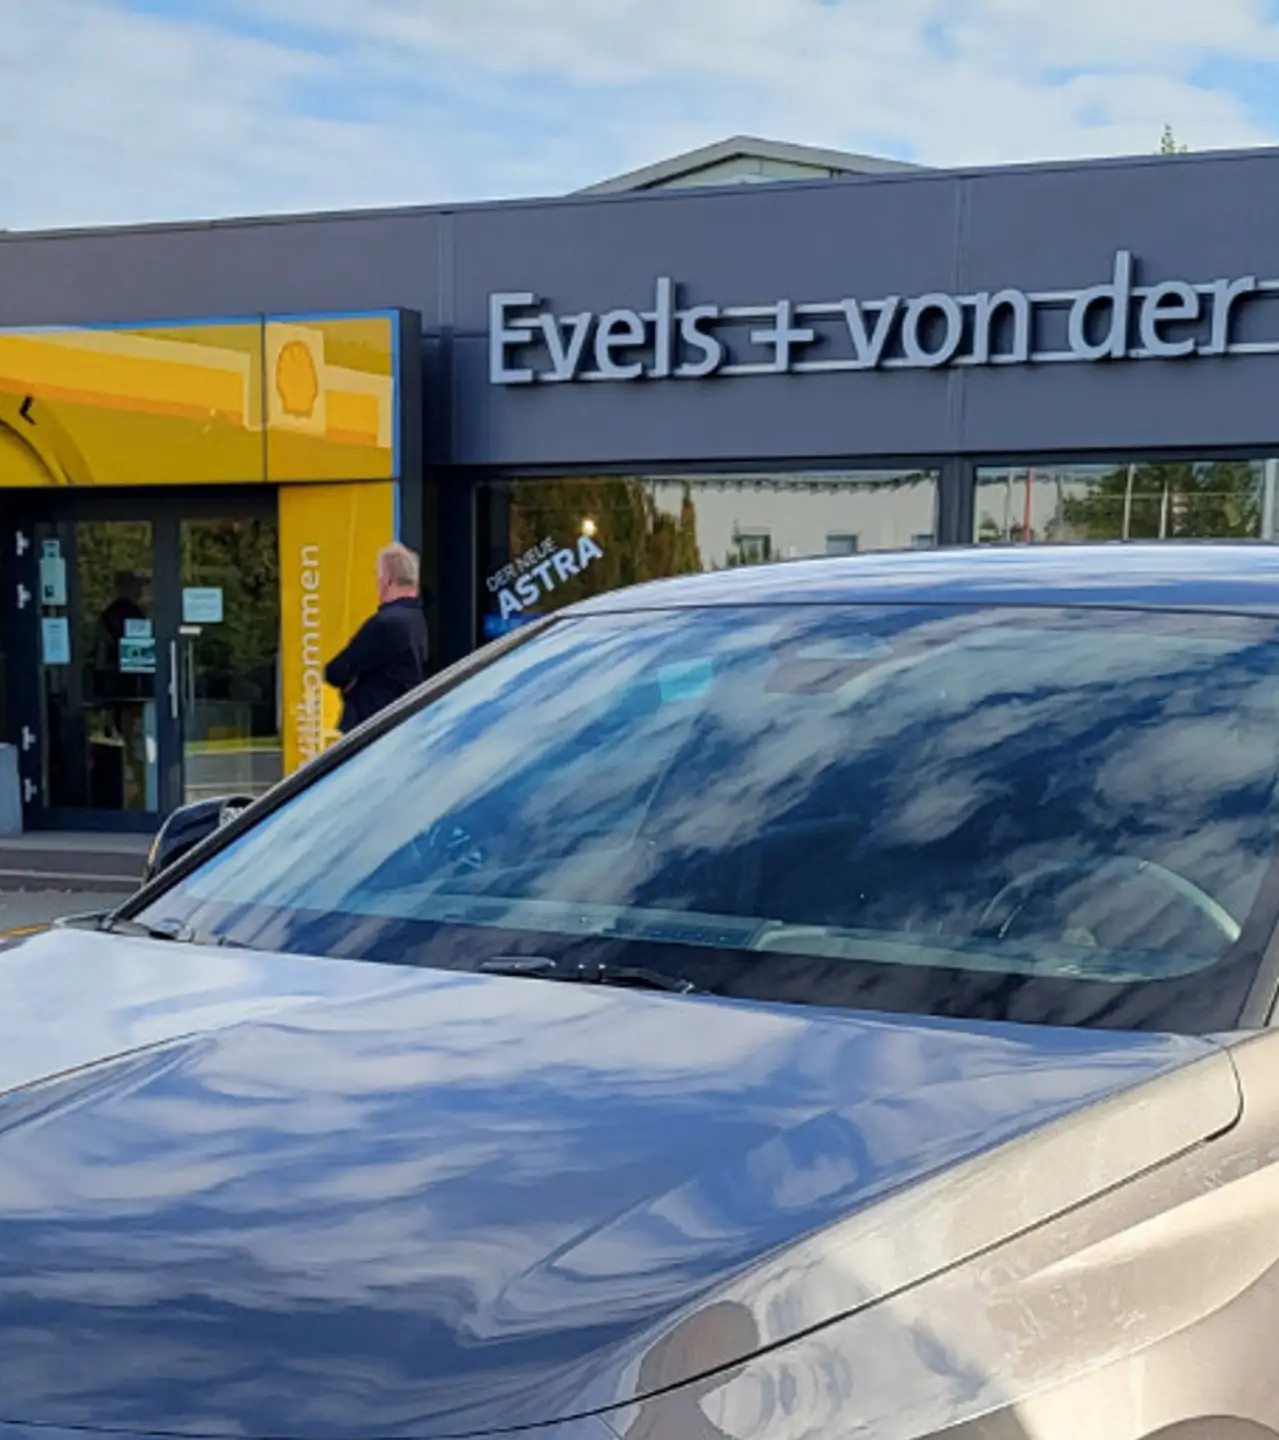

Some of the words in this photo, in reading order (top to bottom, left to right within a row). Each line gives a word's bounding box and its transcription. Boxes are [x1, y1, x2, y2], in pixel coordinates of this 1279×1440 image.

[489, 276, 722, 384] Evels
[750, 300, 814, 373] +
[839, 289, 1031, 368] von
[1067, 249, 1258, 359] der
[486, 564, 517, 592] DER
[515, 537, 557, 572] NEUE
[497, 535, 604, 620] ASTRA
